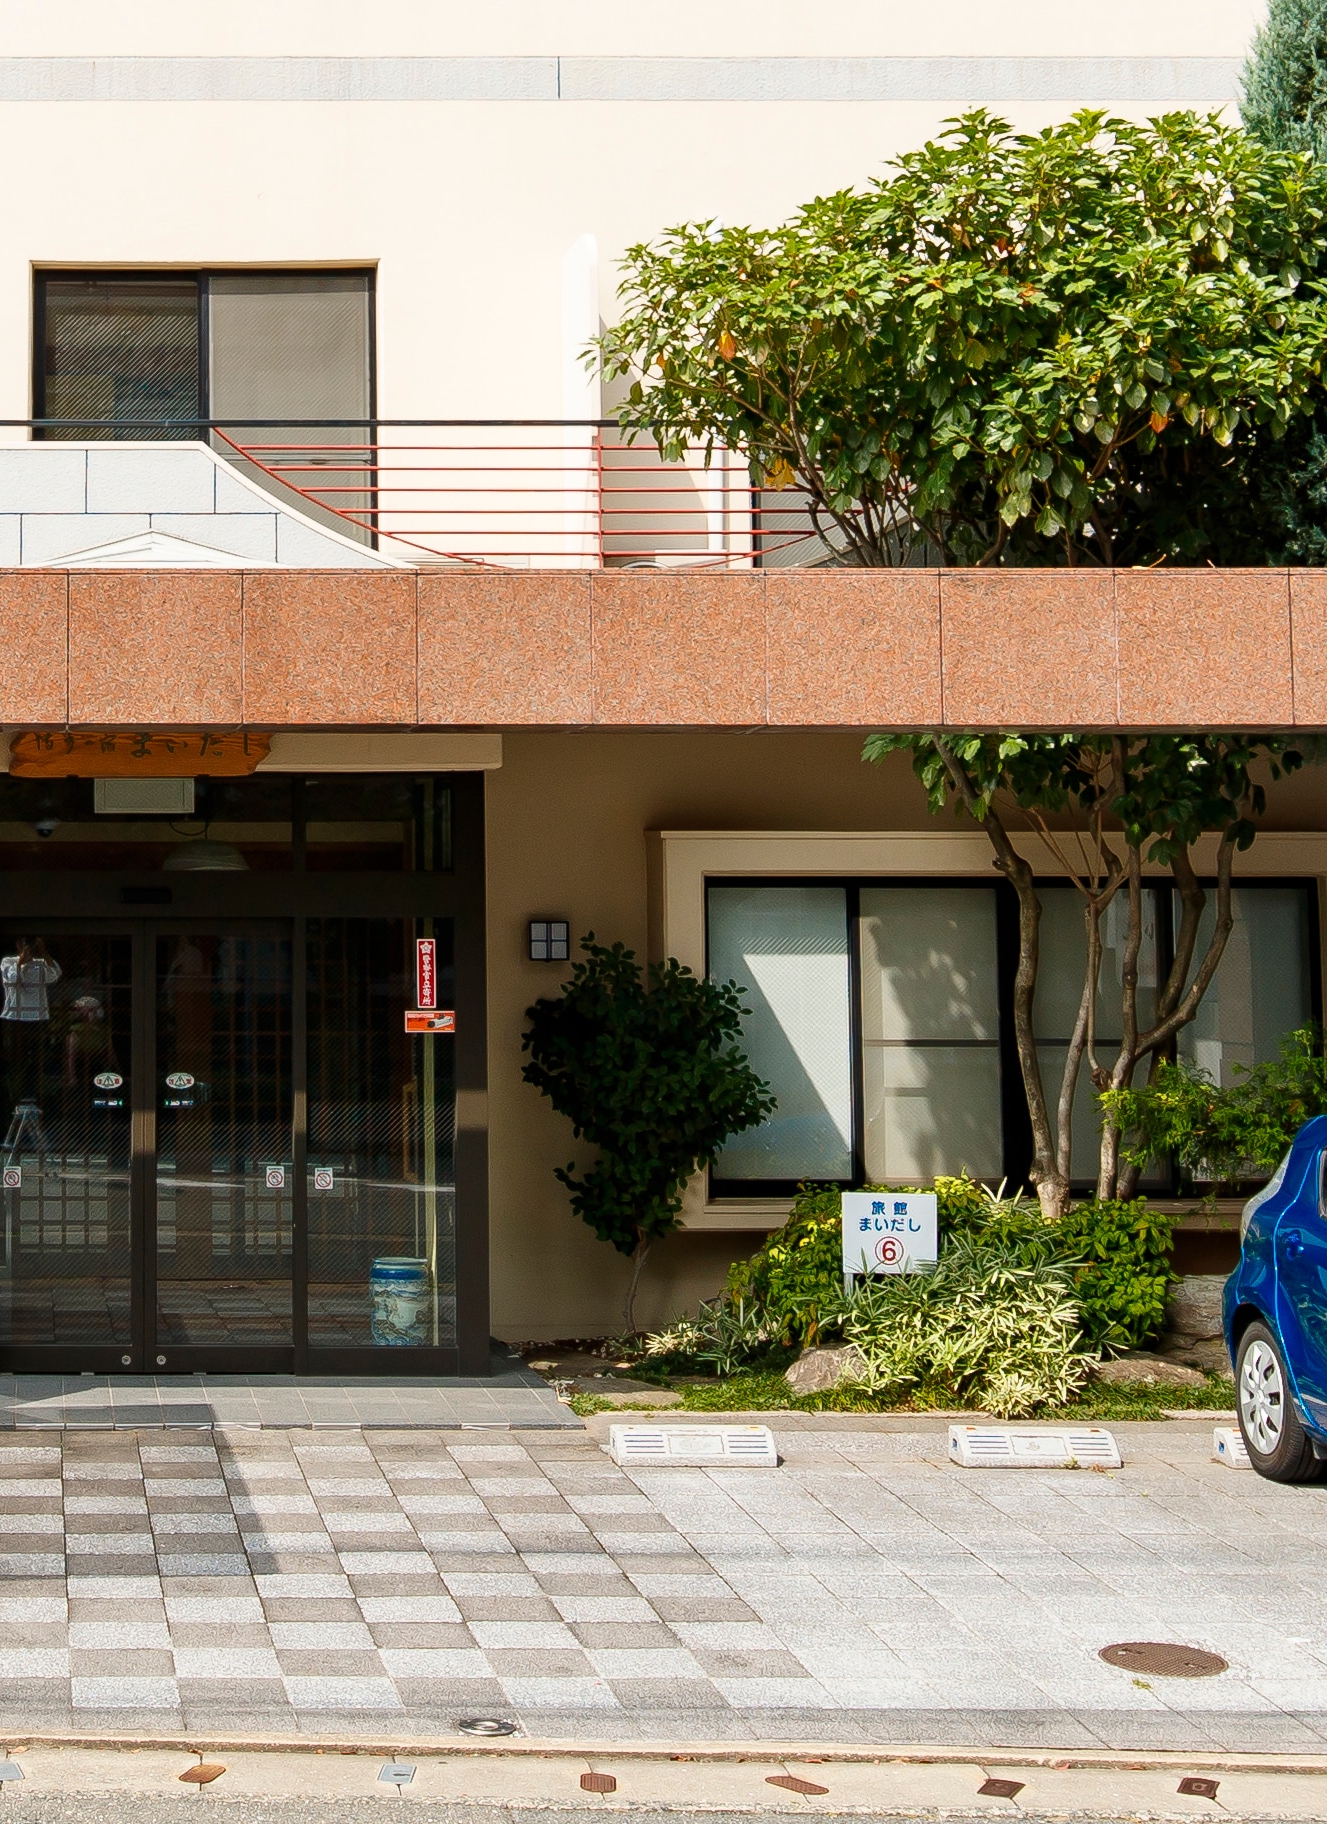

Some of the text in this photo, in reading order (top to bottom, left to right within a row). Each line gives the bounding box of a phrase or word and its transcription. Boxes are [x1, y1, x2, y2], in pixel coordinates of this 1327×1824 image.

[871, 1201, 908, 1216] 旅館
[858, 1218, 922, 1233] まいだし
